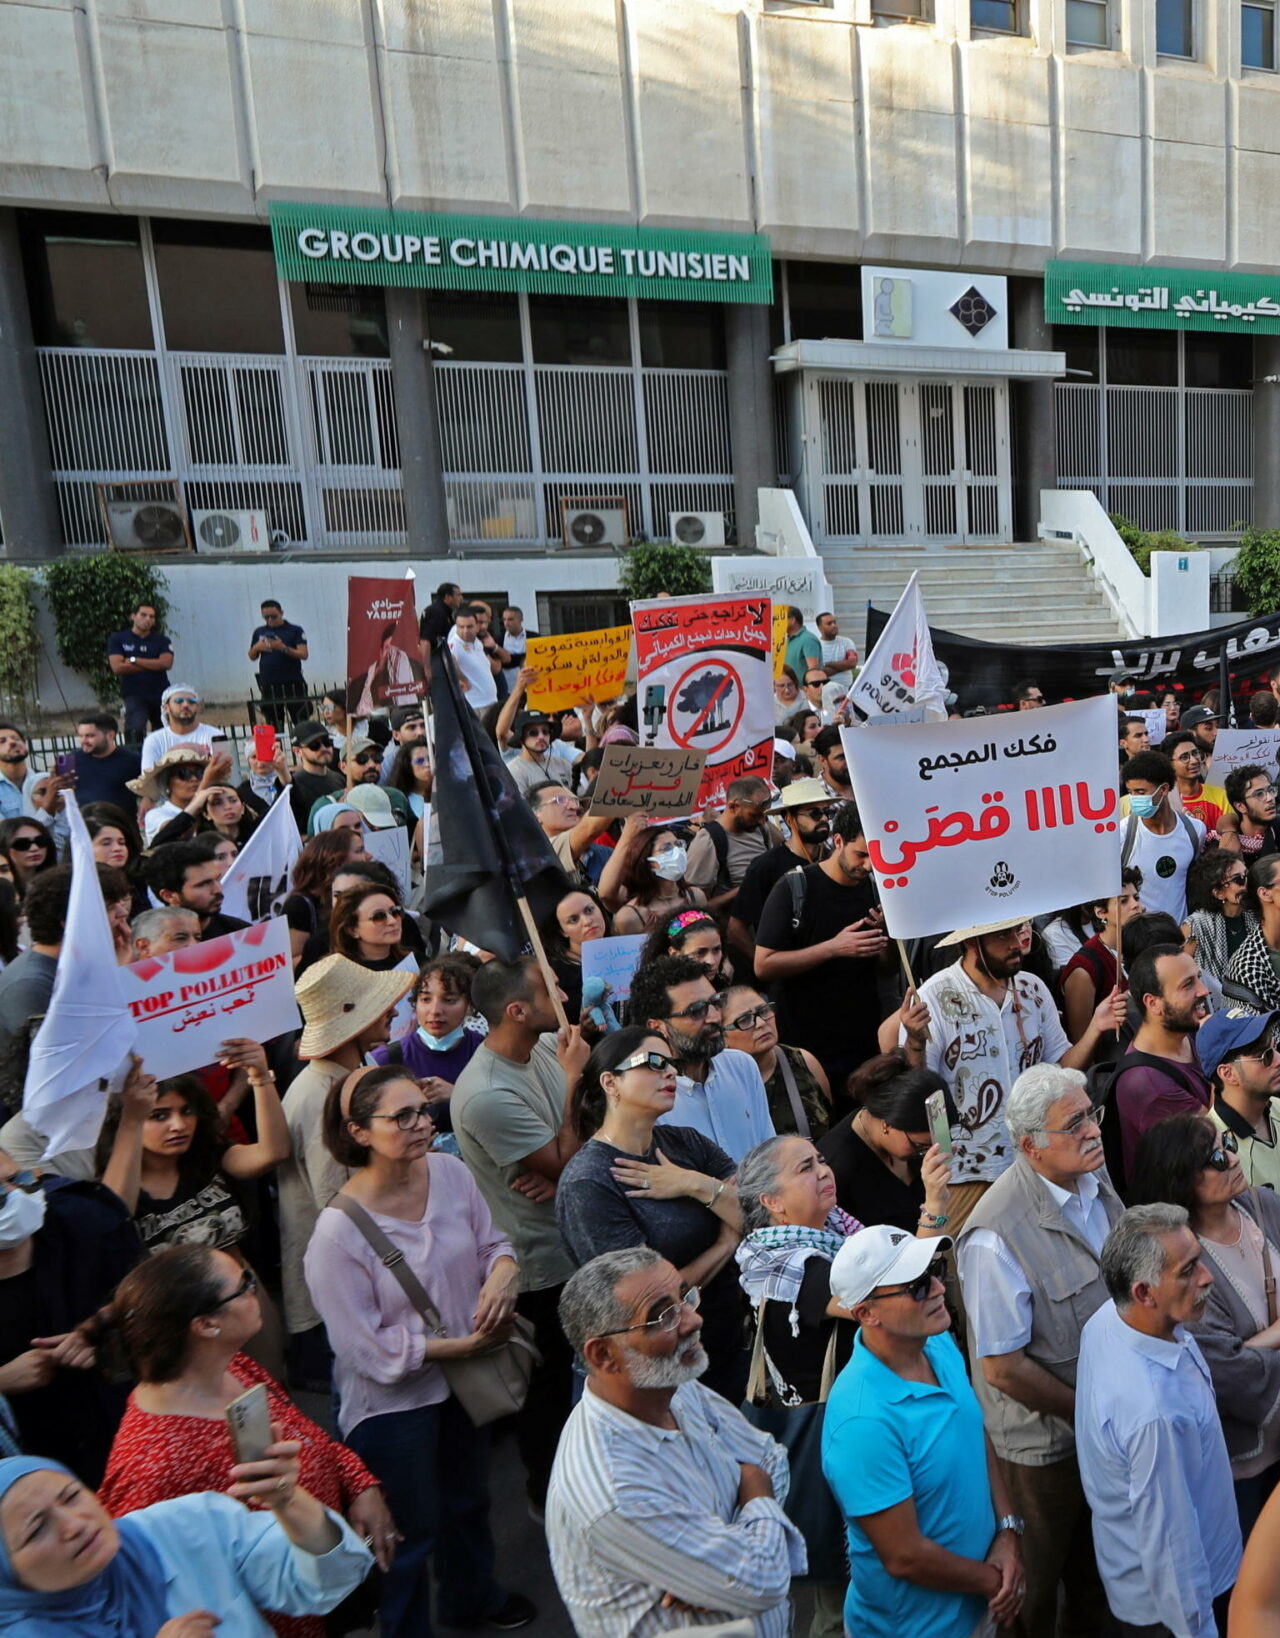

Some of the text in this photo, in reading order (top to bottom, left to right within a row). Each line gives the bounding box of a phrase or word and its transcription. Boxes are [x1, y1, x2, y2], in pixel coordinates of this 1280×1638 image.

[298, 227, 751, 282] GROUPE CHIMIQUE TUNISIEN
[1062, 286, 1169, 312] التونسي
[683, 610, 709, 627] حتى
[711, 606, 746, 625] تراجع
[746, 602, 767, 625] لا
[880, 674, 915, 704] STOP
[919, 733, 1058, 781] فكك المجمع
[128, 952, 287, 1018] TOP POLLUTION
